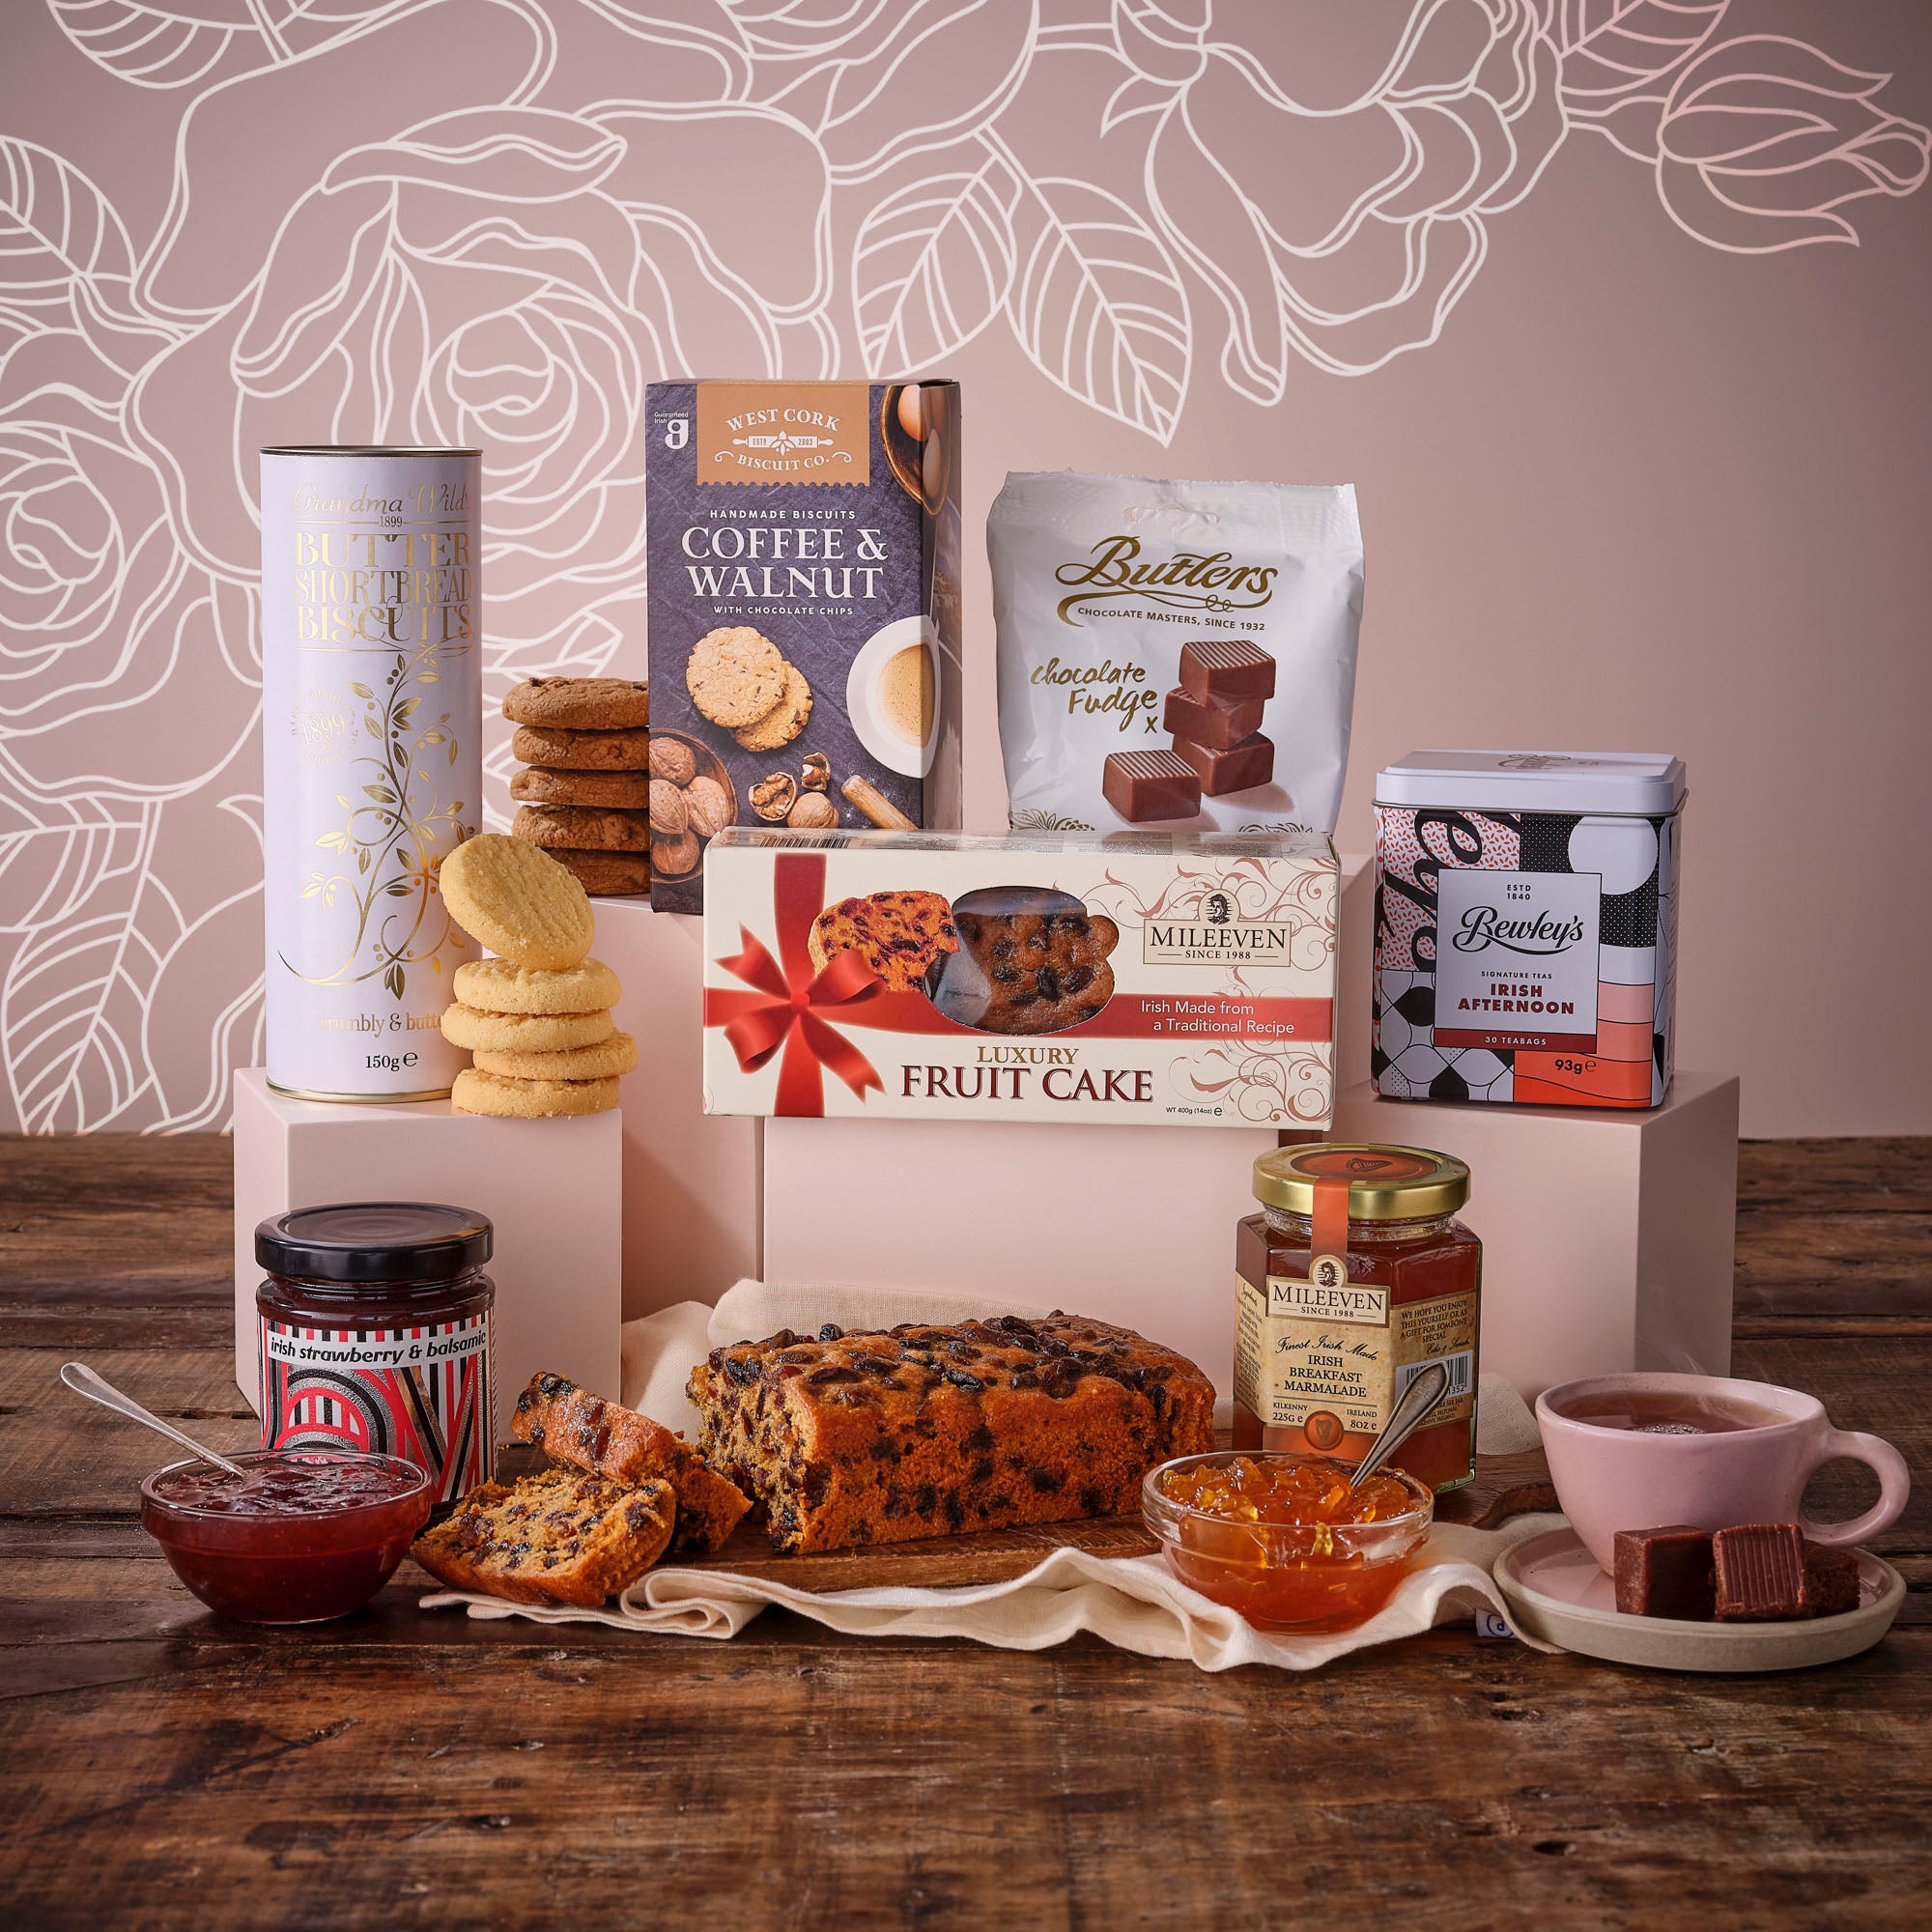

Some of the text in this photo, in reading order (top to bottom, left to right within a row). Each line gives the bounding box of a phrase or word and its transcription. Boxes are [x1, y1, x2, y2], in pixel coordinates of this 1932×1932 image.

[726, 408, 841, 432] WEST CORK
[737, 454, 800, 470] BISCUIT
[379, 516, 403, 527] 1899
[710, 509, 856, 520] HANDMADE BISCUITS
[296, 532, 471, 568] BUTTER
[681, 526, 889, 561] COFFEE &
[685, 566, 884, 599] WALNUT
[1055, 535, 1279, 611] Butlers
[295, 568, 472, 605] SHORTBREAD
[714, 606, 742, 614] WITH
[1078, 607, 1265, 631] CHOCOLATE MASTERS, SINCE 1932
[296, 605, 473, 644] BISCUITS
[1030, 658, 1146, 685] chocolate
[1068, 688, 1158, 732] Fudge
[1507, 884, 1531, 893] ESTD
[1150, 925, 1287, 950] MILEEVEN
[1452, 906, 1584, 955] Bewley's
[1185, 950, 1251, 960] SINCE 1988
[1481, 971, 1529, 980] SIGNATURE
[1491, 982, 1543, 997] IRISH
[1141, 1000, 1254, 1015] Irish Made from
[1458, 999, 1575, 1014] AFTERNOON
[389, 1013, 402, 1032] &
[1153, 1018, 1294, 1037] a Traditional Recipe
[1485, 1036, 1547, 1045] 30 TEABAGS
[365, 1055, 400, 1071] 150g
[977, 1046, 1079, 1065] LUXURY
[1554, 1059, 1582, 1075] 93g
[900, 1065, 1153, 1103] FRUIT CAKE
[1273, 1284, 1384, 1312] MILEEVEN
[1300, 1306, 1354, 1318] SINCE 1988
[1414, 1308, 1432, 1318] HOPE
[1434, 1304, 1447, 1314] YOU
[1448, 1298, 1468, 1309] ENJOY
[1401, 1320, 1417, 1329] THIS
[1418, 1313, 1449, 1325] YOURSELF
[1450, 1310, 1459, 1319] OR
[1406, 1328, 1421, 1338] GIFT
[1423, 1324, 1436, 1333] FOR
[1436, 1318, 1467, 1331] SOMEONE
[1422, 1332, 1446, 1343] SPECIAL
[270, 1330, 487, 1365] irish strawberry & balsamic
[1275, 1335, 1378, 1360] Finest Irish Made
[1308, 1354, 1344, 1367] IRISH
[1290, 1367, 1362, 1382] BREAKFAST
[1284, 1380, 1367, 1397] MARMALADE
[1273, 1402, 1308, 1411] KILKENNY
[1347, 1408, 1378, 1418] IRELAND
